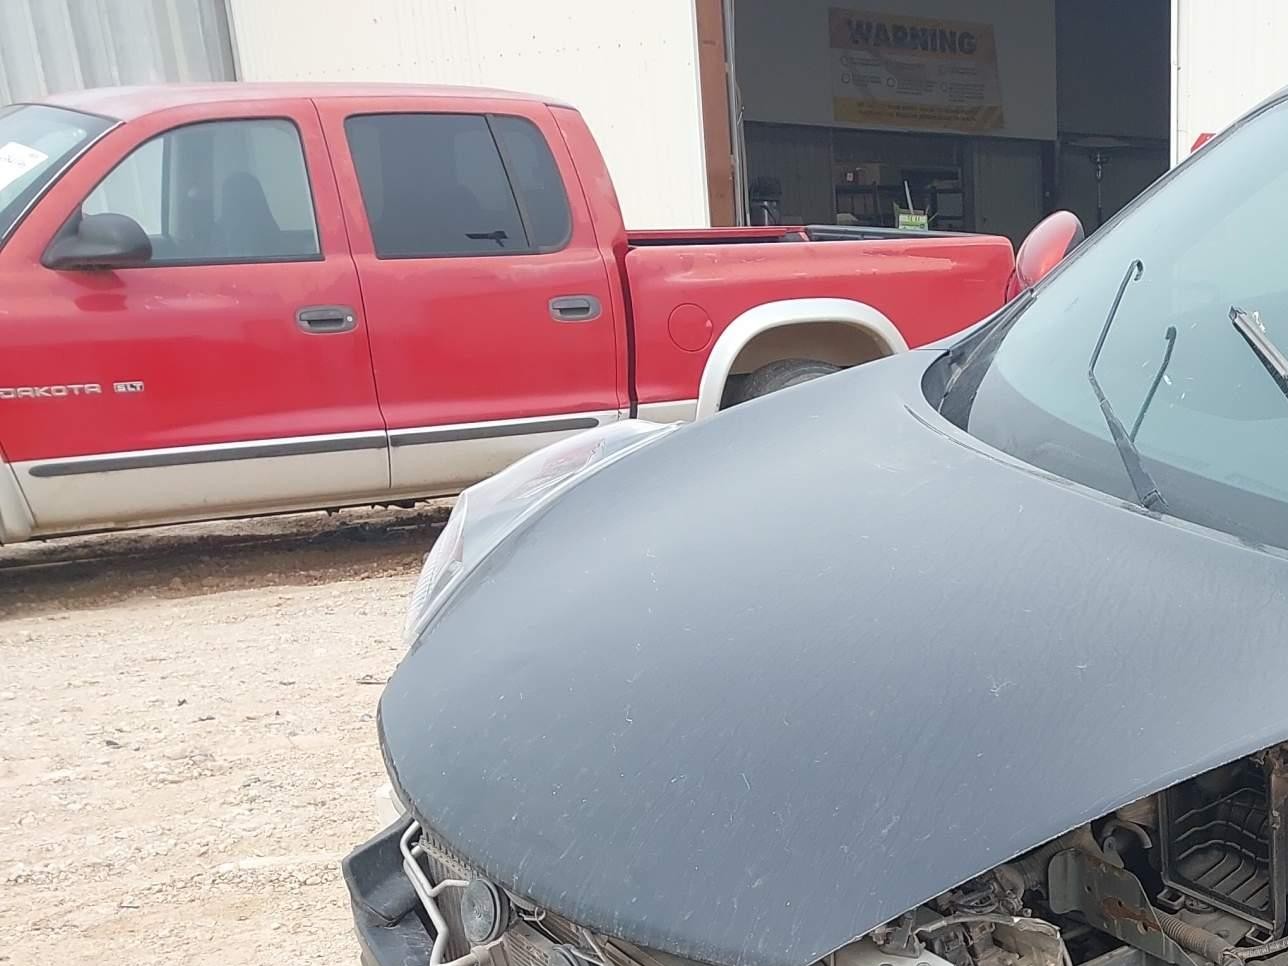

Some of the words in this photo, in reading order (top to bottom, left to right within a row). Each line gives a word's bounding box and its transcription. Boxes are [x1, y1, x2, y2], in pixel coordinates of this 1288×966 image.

[848, 19, 977, 55] WARNING
[0, 383, 102, 399] DAKOTA
[114, 382, 144, 392] SLT
